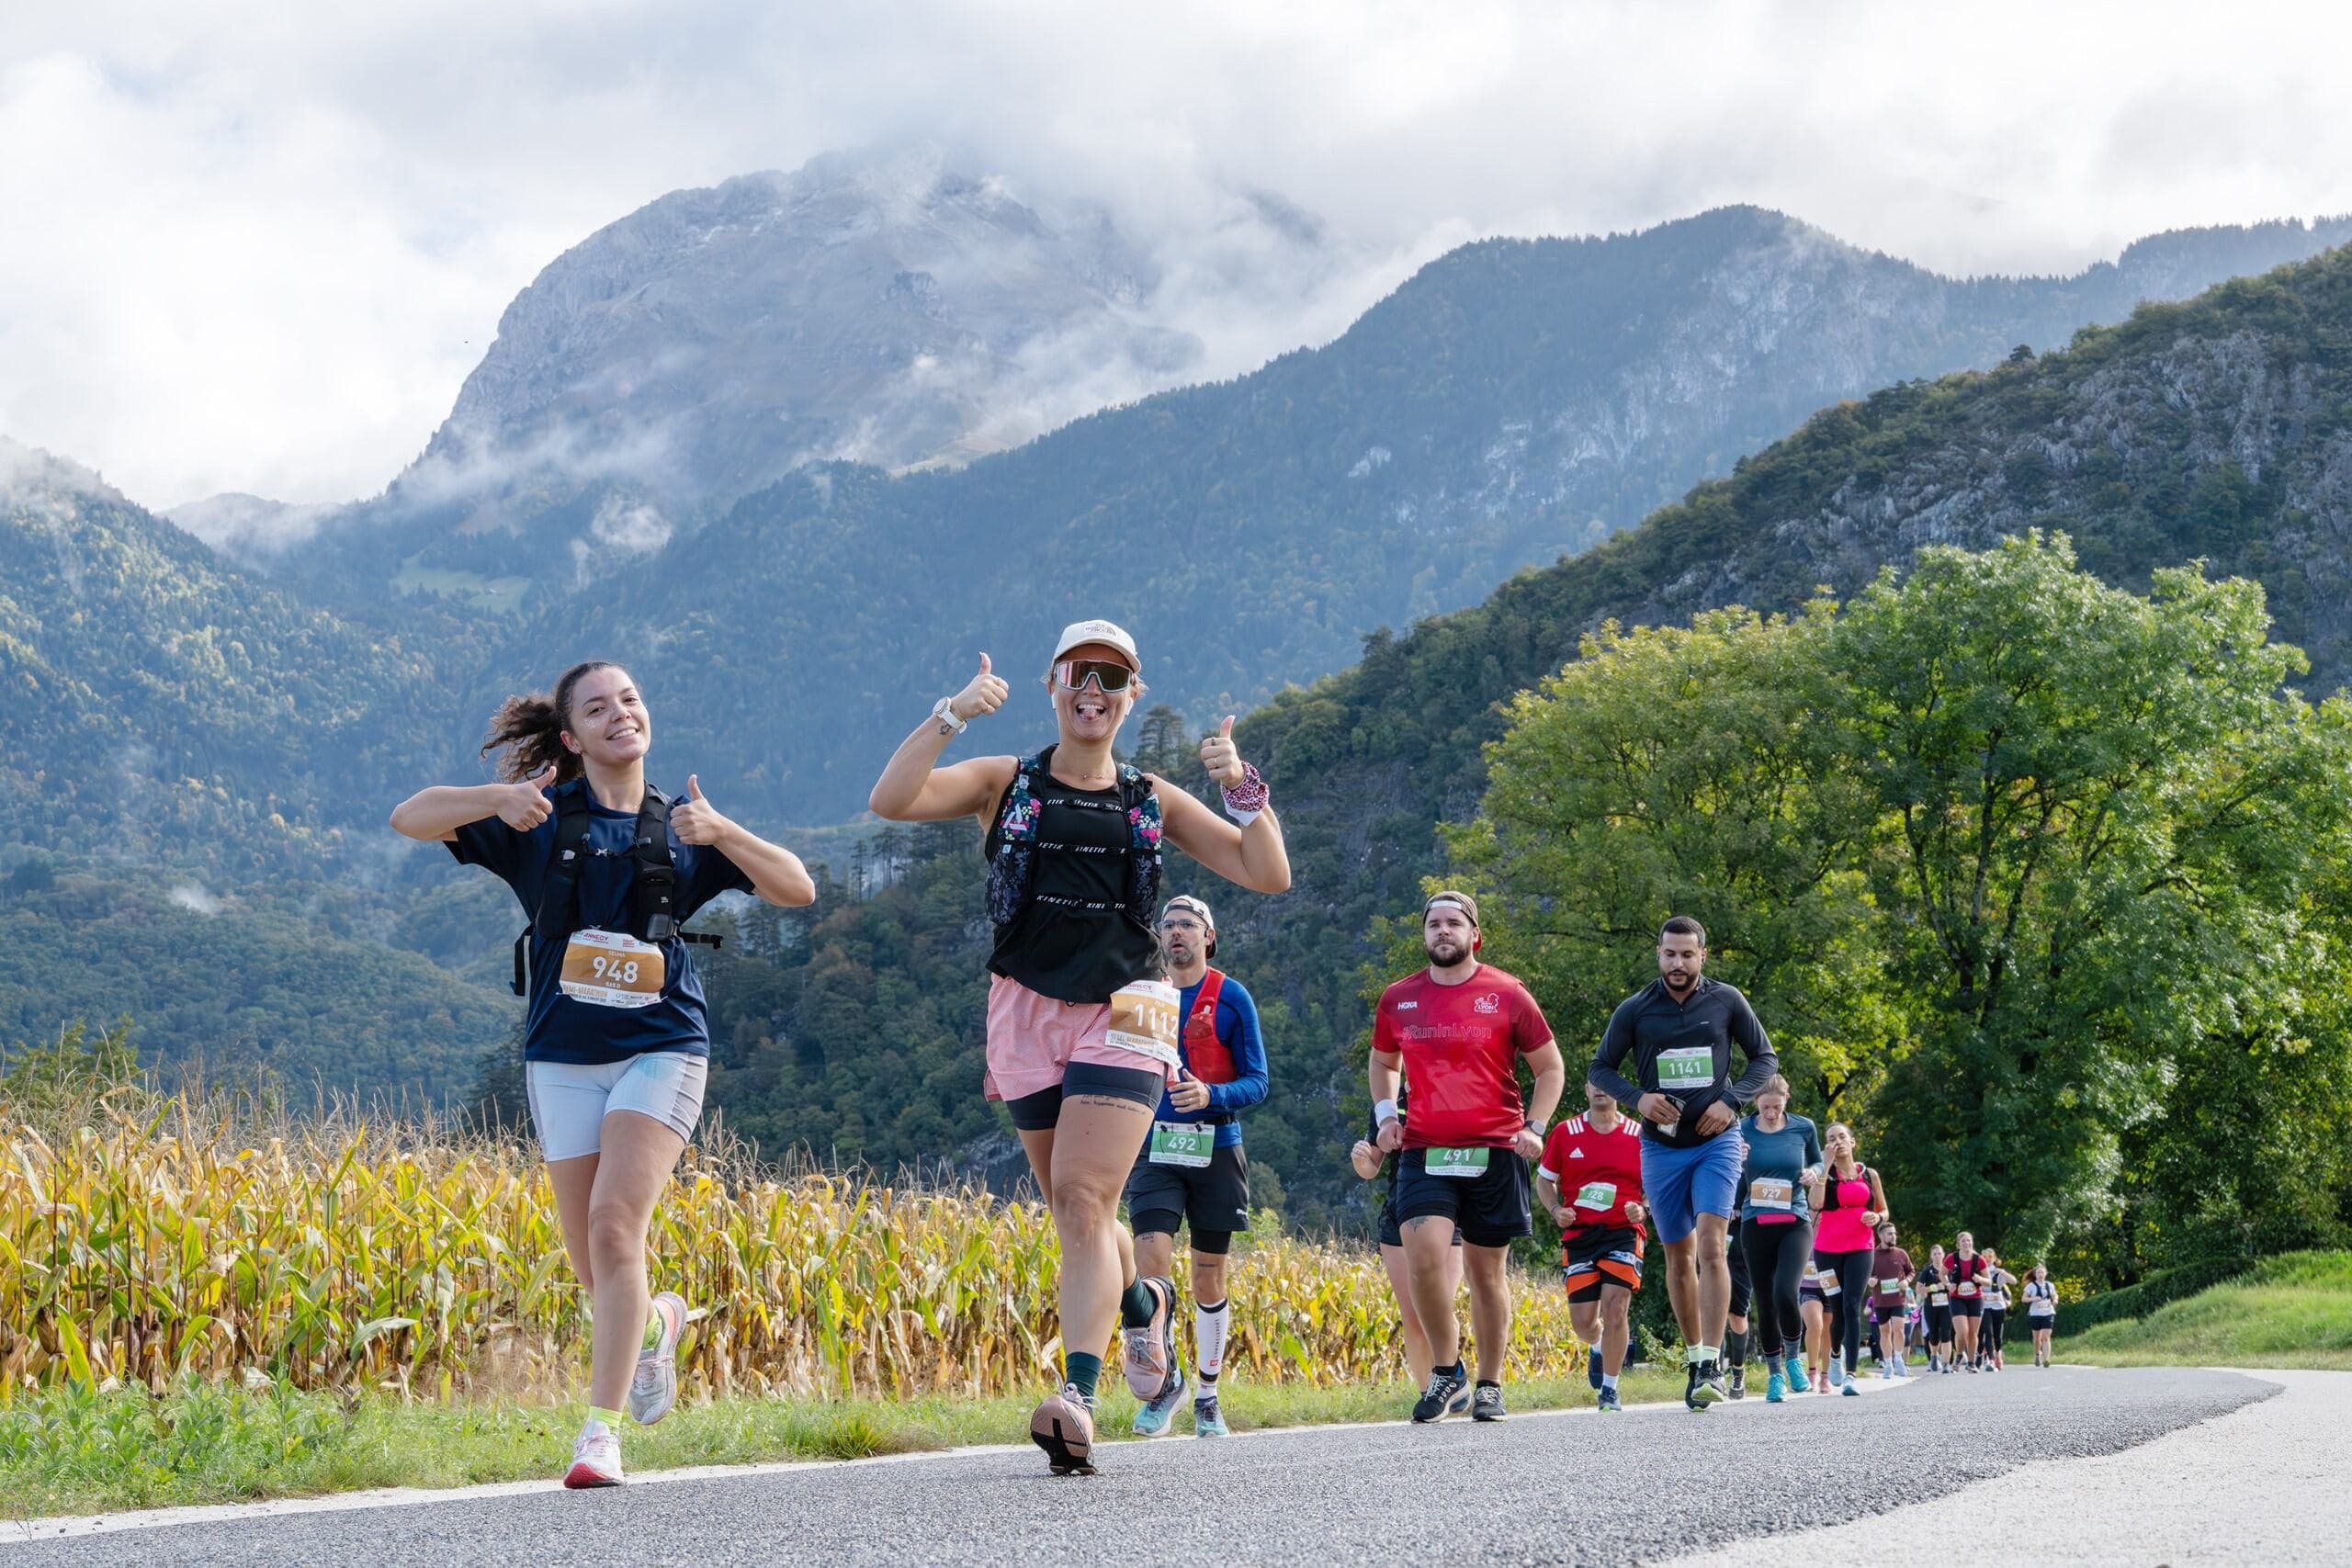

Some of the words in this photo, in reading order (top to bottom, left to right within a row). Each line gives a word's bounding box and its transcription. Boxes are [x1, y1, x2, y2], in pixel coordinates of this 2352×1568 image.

[593, 956, 639, 984] 948
[1397, 1001, 1418, 1010] HOKA
[1135, 1003, 1178, 1040] 1112
[1669, 1061, 1701, 1076] 1141
[1168, 1135, 1196, 1151] 492
[1443, 1148, 1470, 1162] 491
[1761, 1188, 1781, 1199] 927
